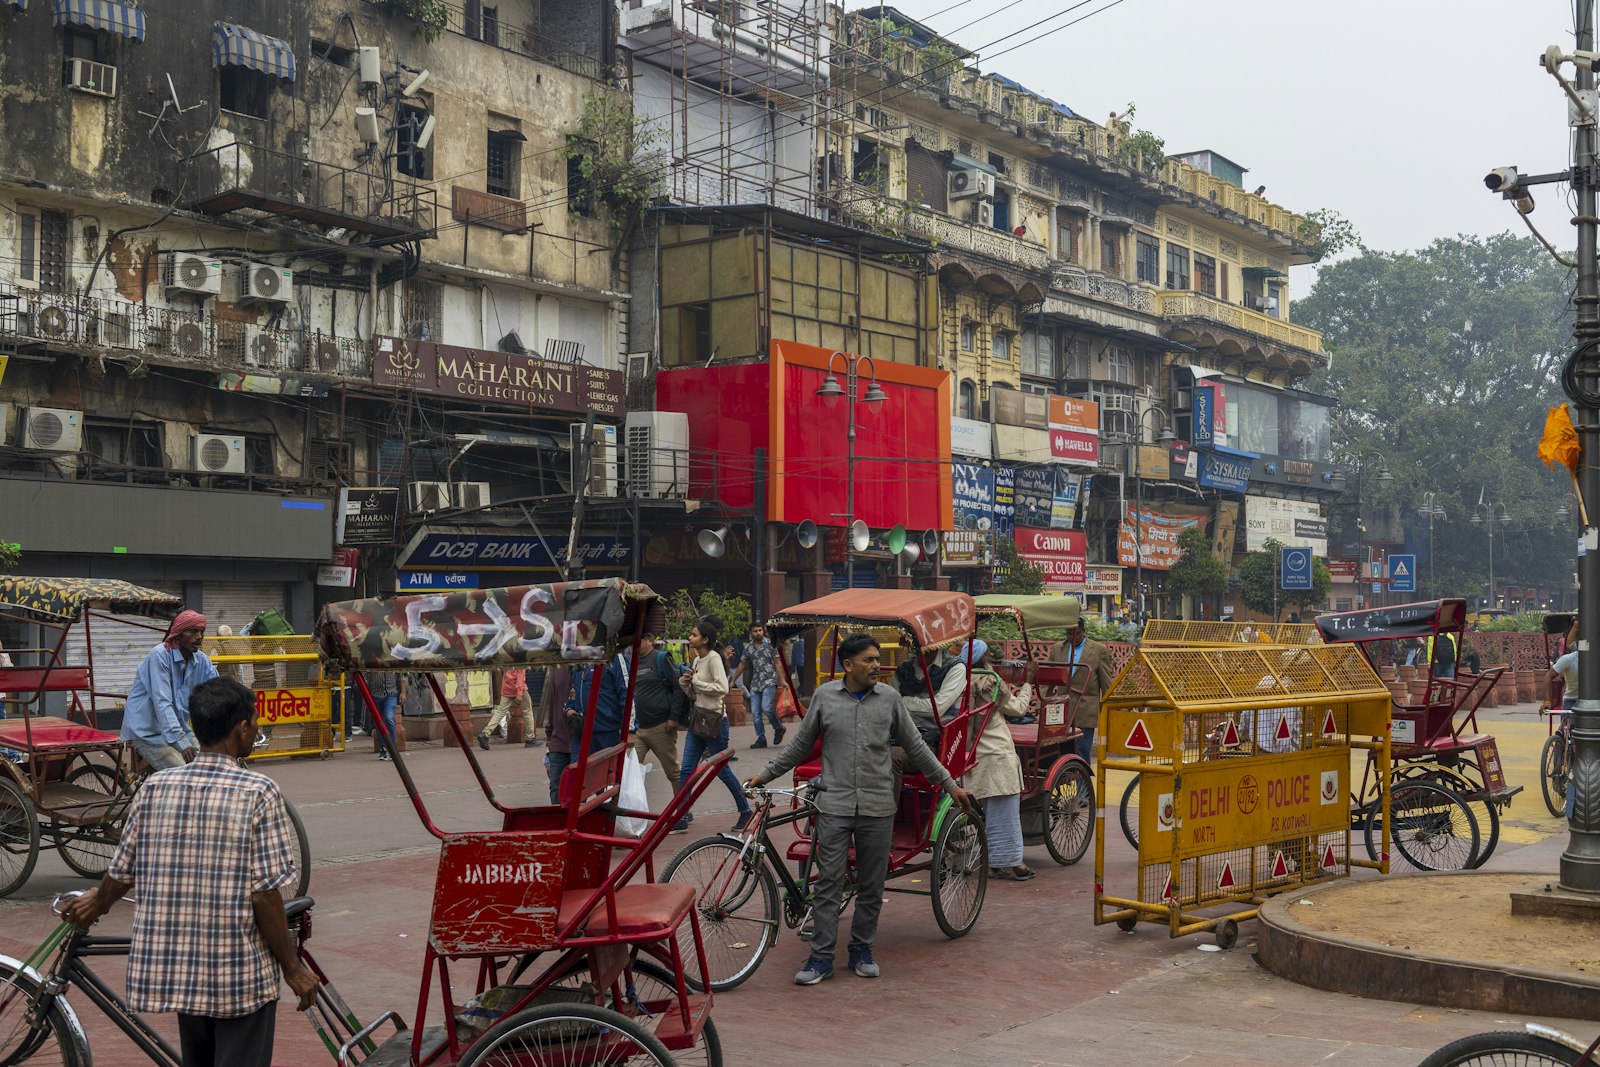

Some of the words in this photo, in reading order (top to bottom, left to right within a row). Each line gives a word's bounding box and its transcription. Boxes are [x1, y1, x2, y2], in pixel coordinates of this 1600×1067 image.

[438, 355, 573, 394] MAHARANI
[589, 369, 611, 380] SARES
[457, 382, 555, 405] COLLECTIONS
[589, 381, 605, 391] SUITS
[1064, 438, 1094, 452] HAVELLS
[1023, 469, 1048, 480] SONY
[1213, 461, 1238, 478] SYSKA
[1238, 466, 1251, 481] LED
[347, 514, 394, 522] MAHARANI
[1248, 520, 1266, 529] SONY
[1297, 521, 1318, 530] Pioneer
[944, 532, 977, 542] PROTEIN
[1033, 533, 1071, 552] Canon
[430, 542, 477, 561] DCB
[479, 544, 538, 559] BANK
[946, 542, 974, 552] WORLD
[1025, 558, 1053, 575] ASTER
[1055, 561, 1083, 575] COLOR
[410, 572, 432, 584] ATM
[266, 689, 311, 723] पुलिस
[1189, 785, 1231, 820] DELHI
[1267, 774, 1311, 811] POLICE
[1281, 813, 1312, 831] KOTWALI
[1192, 825, 1216, 844] NORTH
[457, 861, 543, 886] JABBAR
